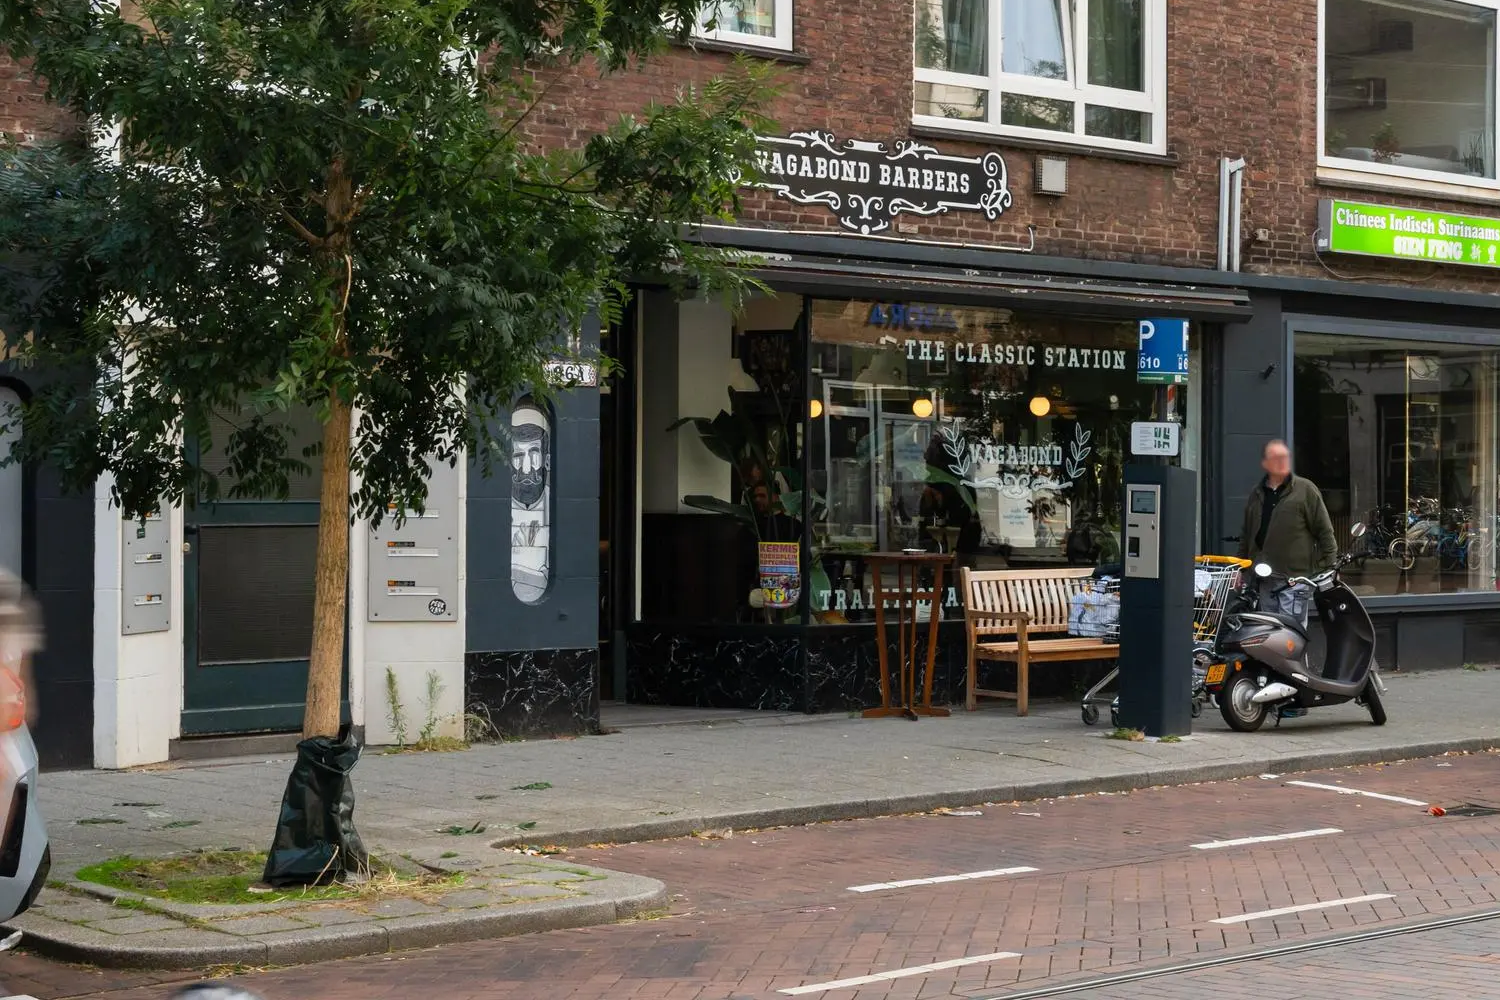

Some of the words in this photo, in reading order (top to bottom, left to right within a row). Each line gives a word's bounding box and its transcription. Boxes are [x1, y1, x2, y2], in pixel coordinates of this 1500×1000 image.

[754, 150, 871, 184] VAGABOND
[879, 164, 970, 194] BARBERS
[1336, 207, 1386, 230] Chinees
[1389, 213, 1435, 235] Indisch
[1438, 218, 1500, 242] Surinaams
[904, 339, 945, 362] THE
[955, 342, 1036, 366] CLASSIC
[1044, 348, 1126, 370] STATION
[968, 443, 1063, 465] VAGABOND
[760, 543, 798, 553] KERMIS
